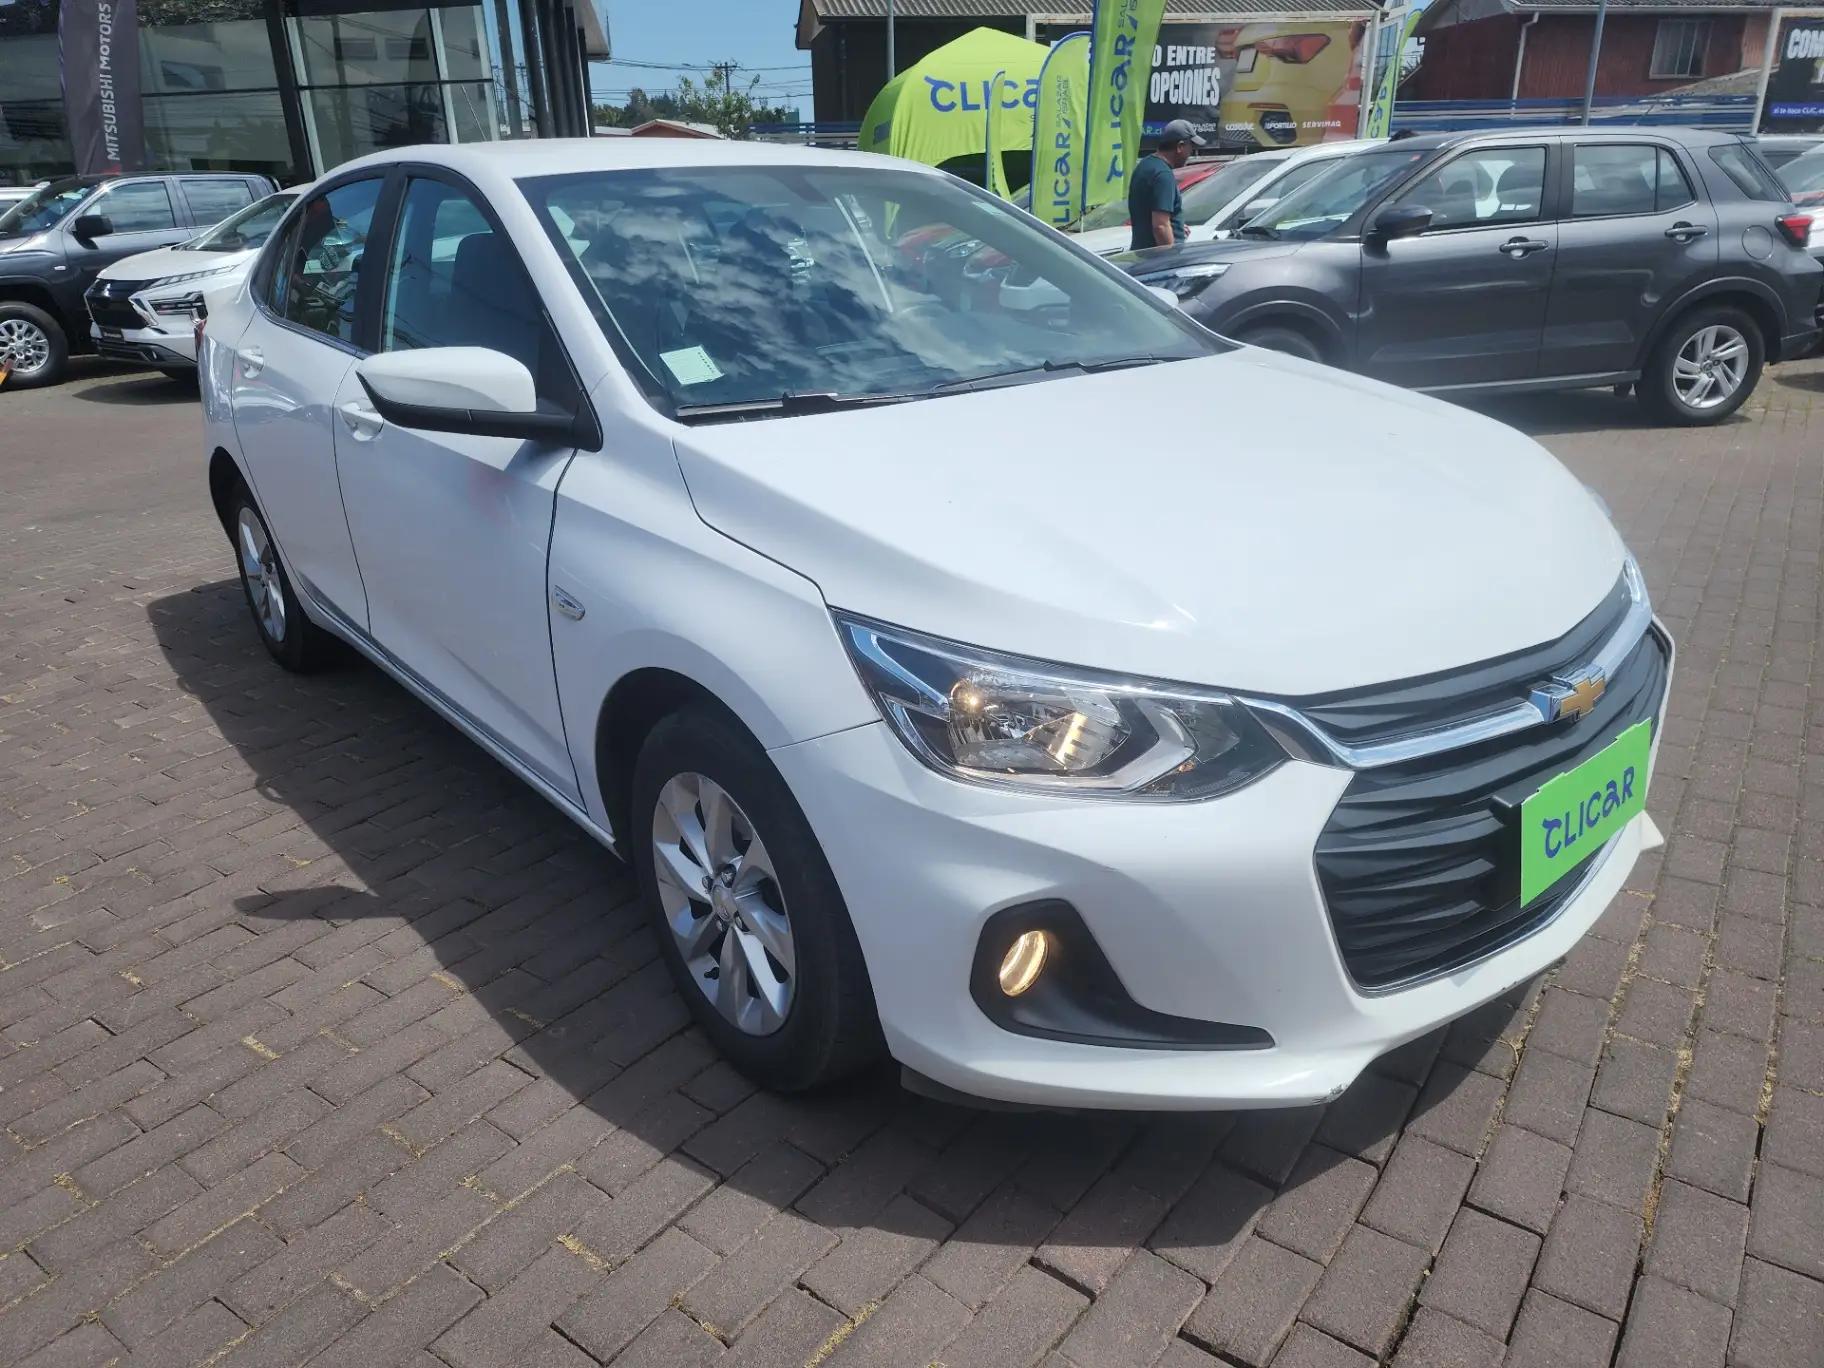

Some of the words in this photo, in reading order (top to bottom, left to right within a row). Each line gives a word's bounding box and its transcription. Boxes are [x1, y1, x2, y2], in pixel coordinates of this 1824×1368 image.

[99, 3, 112, 70] MOTORS
[1167, 45, 1216, 66] ENTRE
[1787, 28, 1824, 59] COM
[1150, 67, 1220, 106] OPCIONES
[100, 73, 120, 161] MITSUBISHI
[1053, 132, 1072, 223] LICaR
